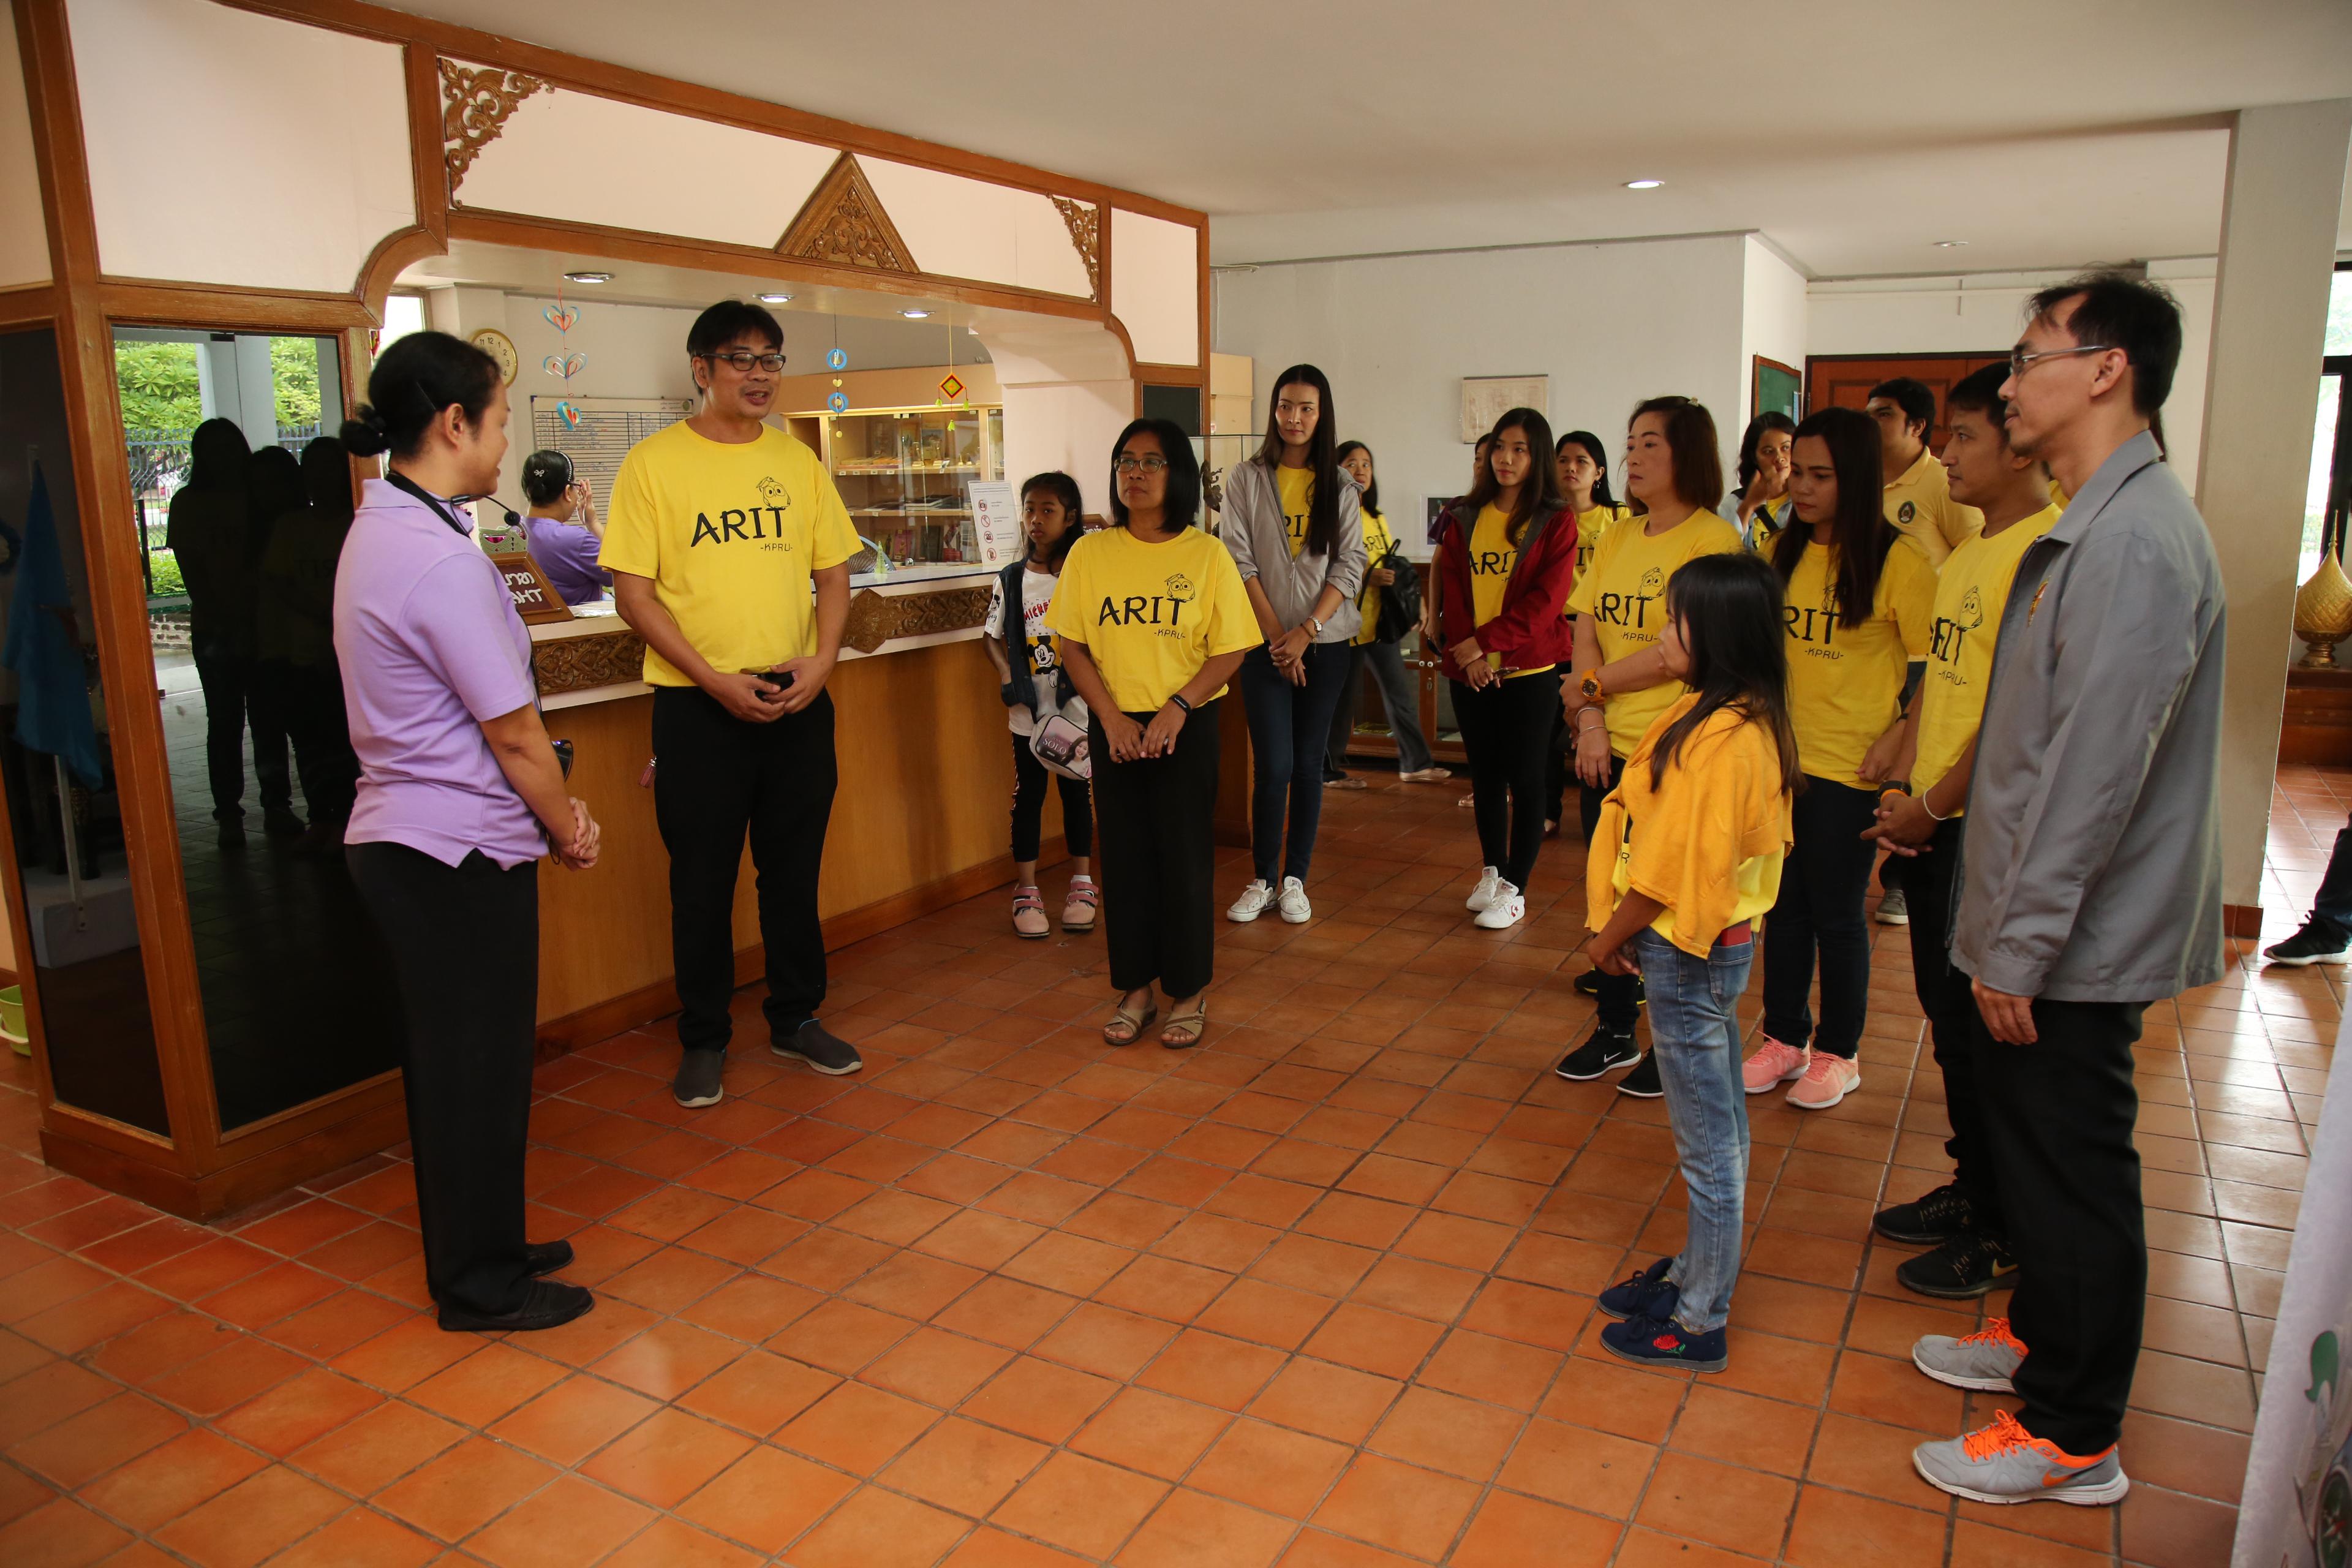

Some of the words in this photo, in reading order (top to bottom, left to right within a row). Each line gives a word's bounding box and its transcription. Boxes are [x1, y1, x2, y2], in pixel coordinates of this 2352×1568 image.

[690, 507, 786, 548] ARIT
[760, 543, 793, 552] -KPRU-
[1023, 598, 1051, 624] MICKE
[1098, 596, 1186, 626] ARIT
[1154, 628, 1186, 639] -KPRU-
[1784, 605, 1841, 644] RIT
[1804, 646, 1844, 660] -KPRU-
[1042, 737, 1067, 755] SOLO
